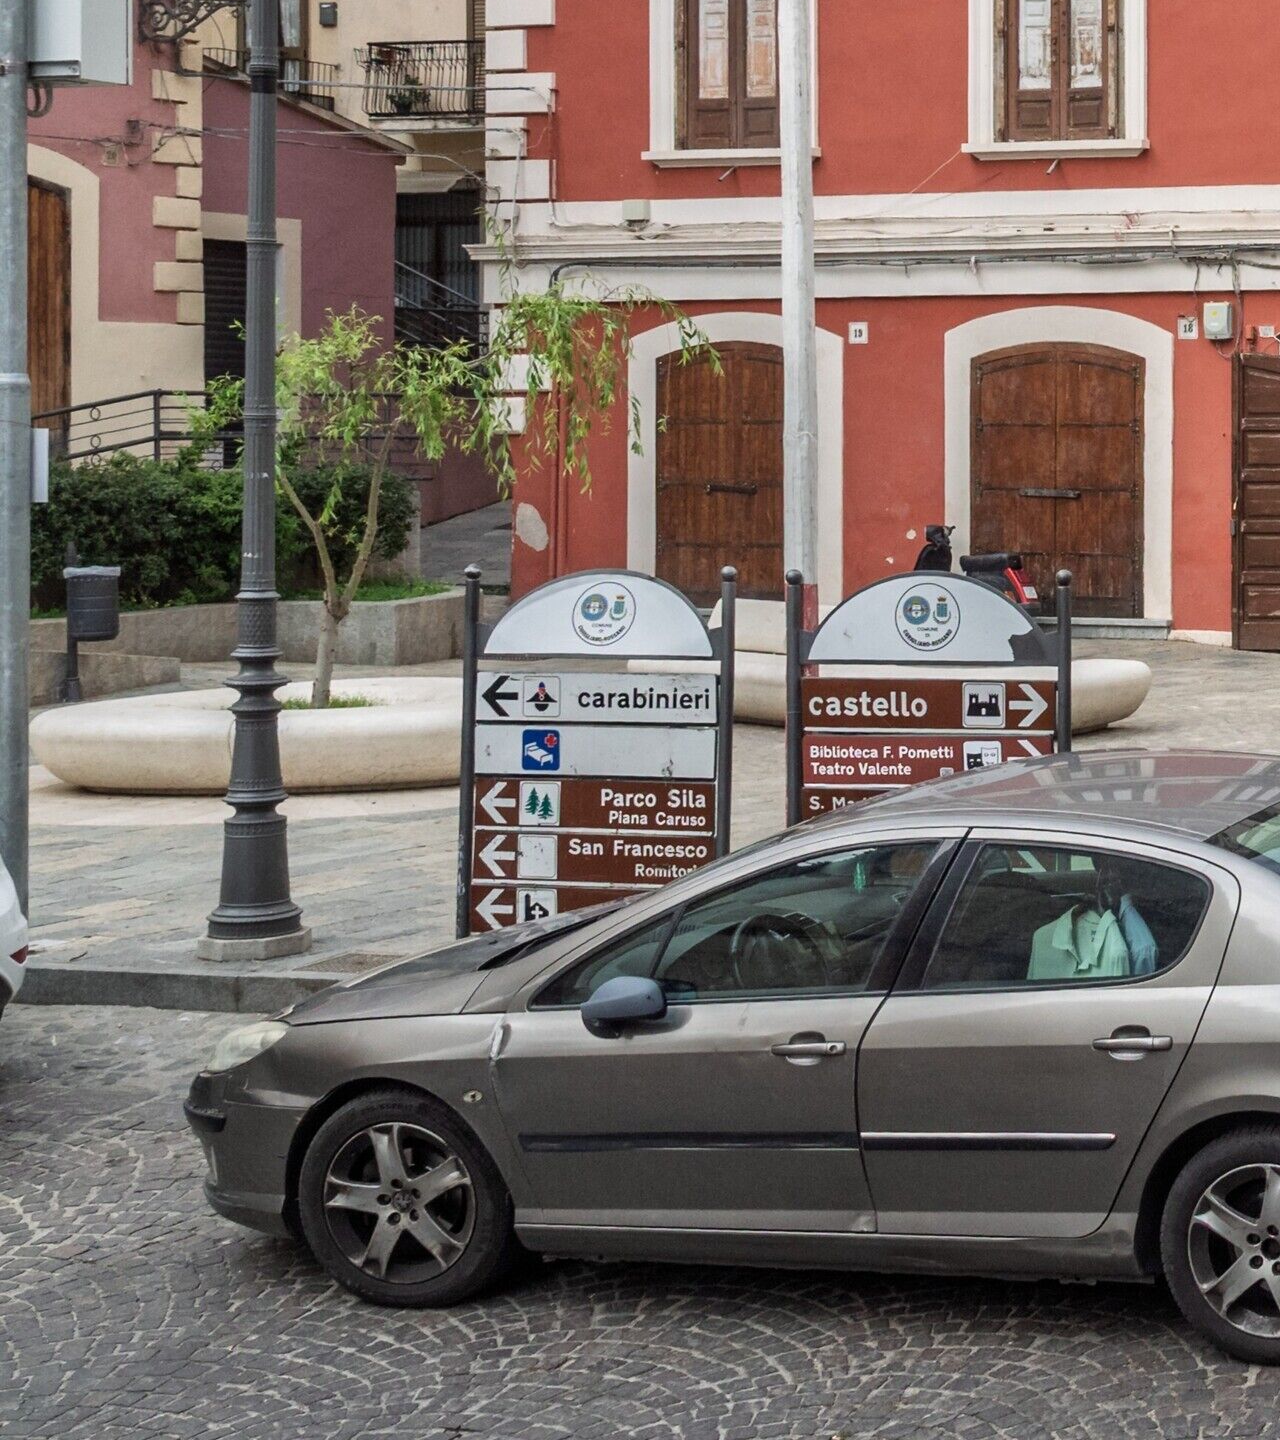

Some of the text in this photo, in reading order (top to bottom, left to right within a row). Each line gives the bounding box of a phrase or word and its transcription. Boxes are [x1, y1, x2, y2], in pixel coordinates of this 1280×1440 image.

[577, 687, 711, 710] carabinieri
[808, 691, 929, 718] castello
[809, 746, 955, 760] Biblioteca F. Pometti
[810, 762, 913, 777] Teatro Valente
[600, 788, 707, 809] Parco Sila
[808, 795, 825, 811] S.
[608, 810, 706, 827] Piana Caruso
[568, 838, 708, 859] San Francesco
